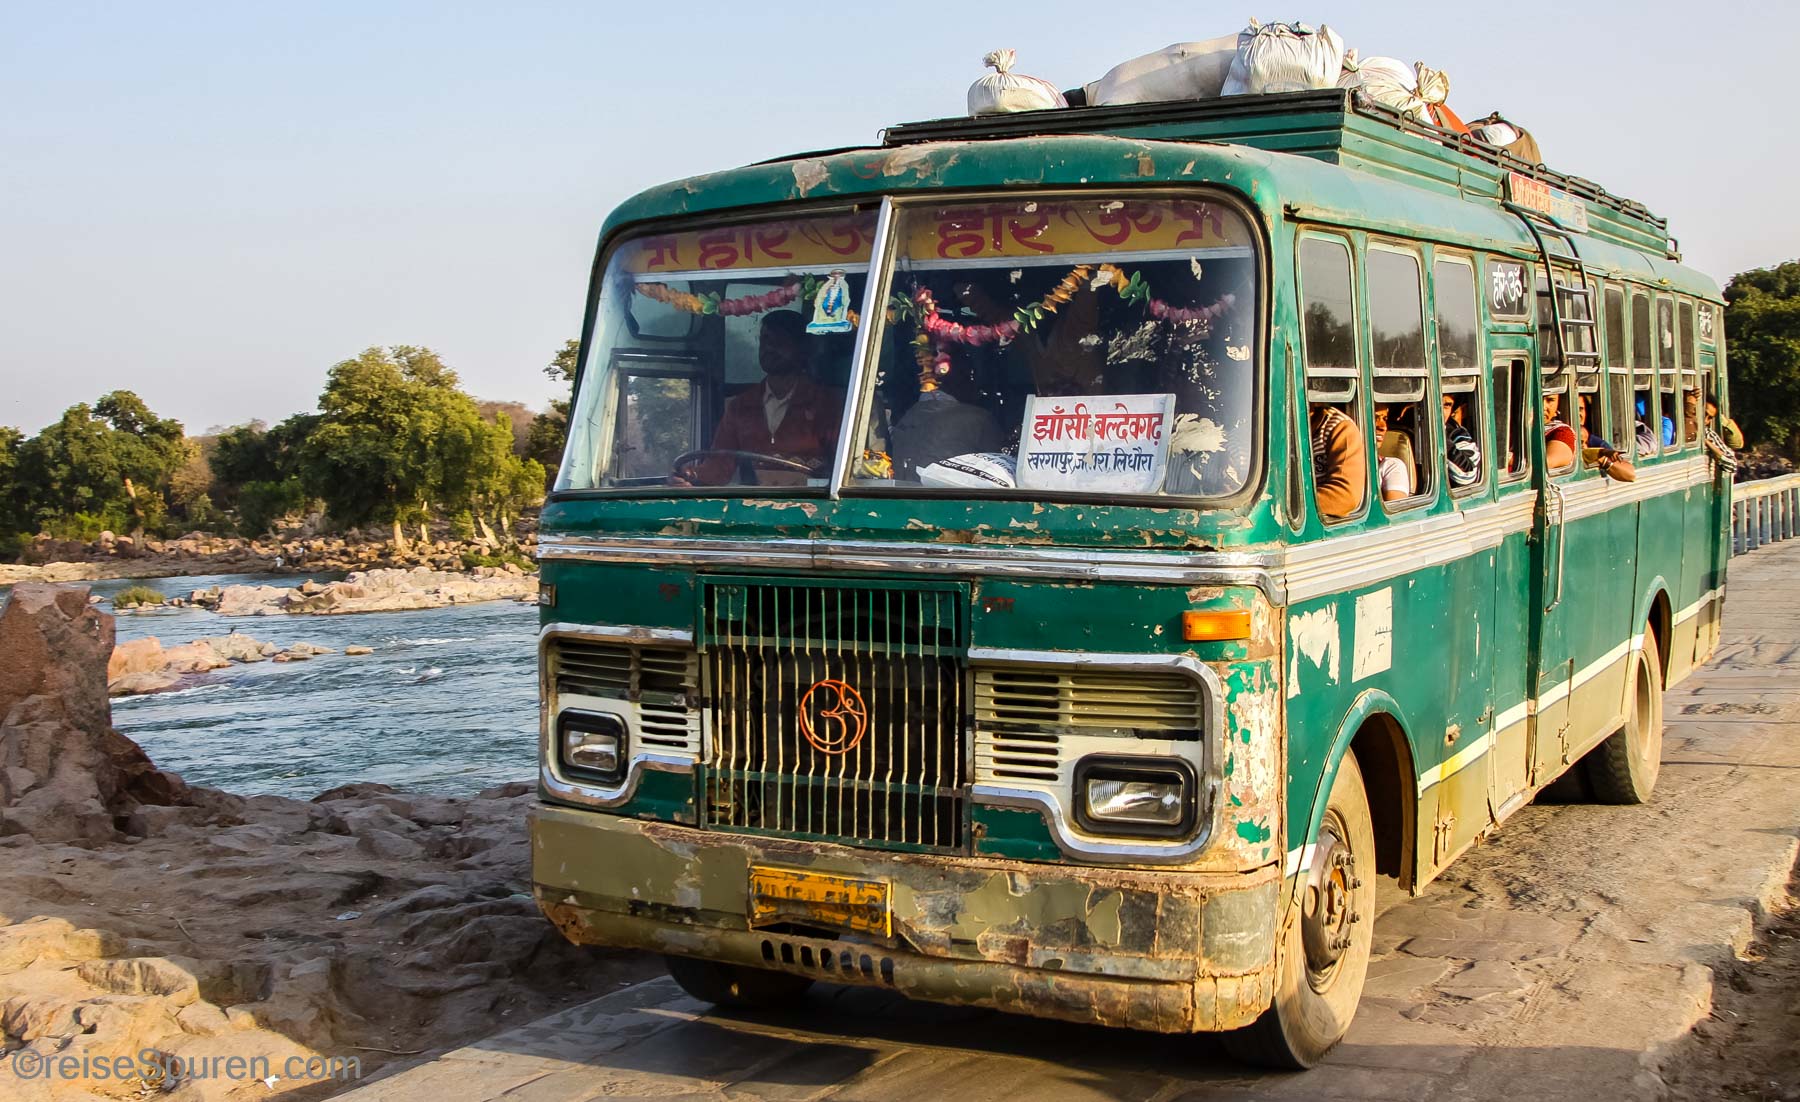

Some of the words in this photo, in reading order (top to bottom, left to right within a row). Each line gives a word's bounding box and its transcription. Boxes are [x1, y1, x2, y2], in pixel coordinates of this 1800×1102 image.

[1033, 403, 1091, 446] झाँसी
[1094, 403, 1164, 446] बल्देवगढ़
[1113, 447, 1154, 472] लिधौरा
